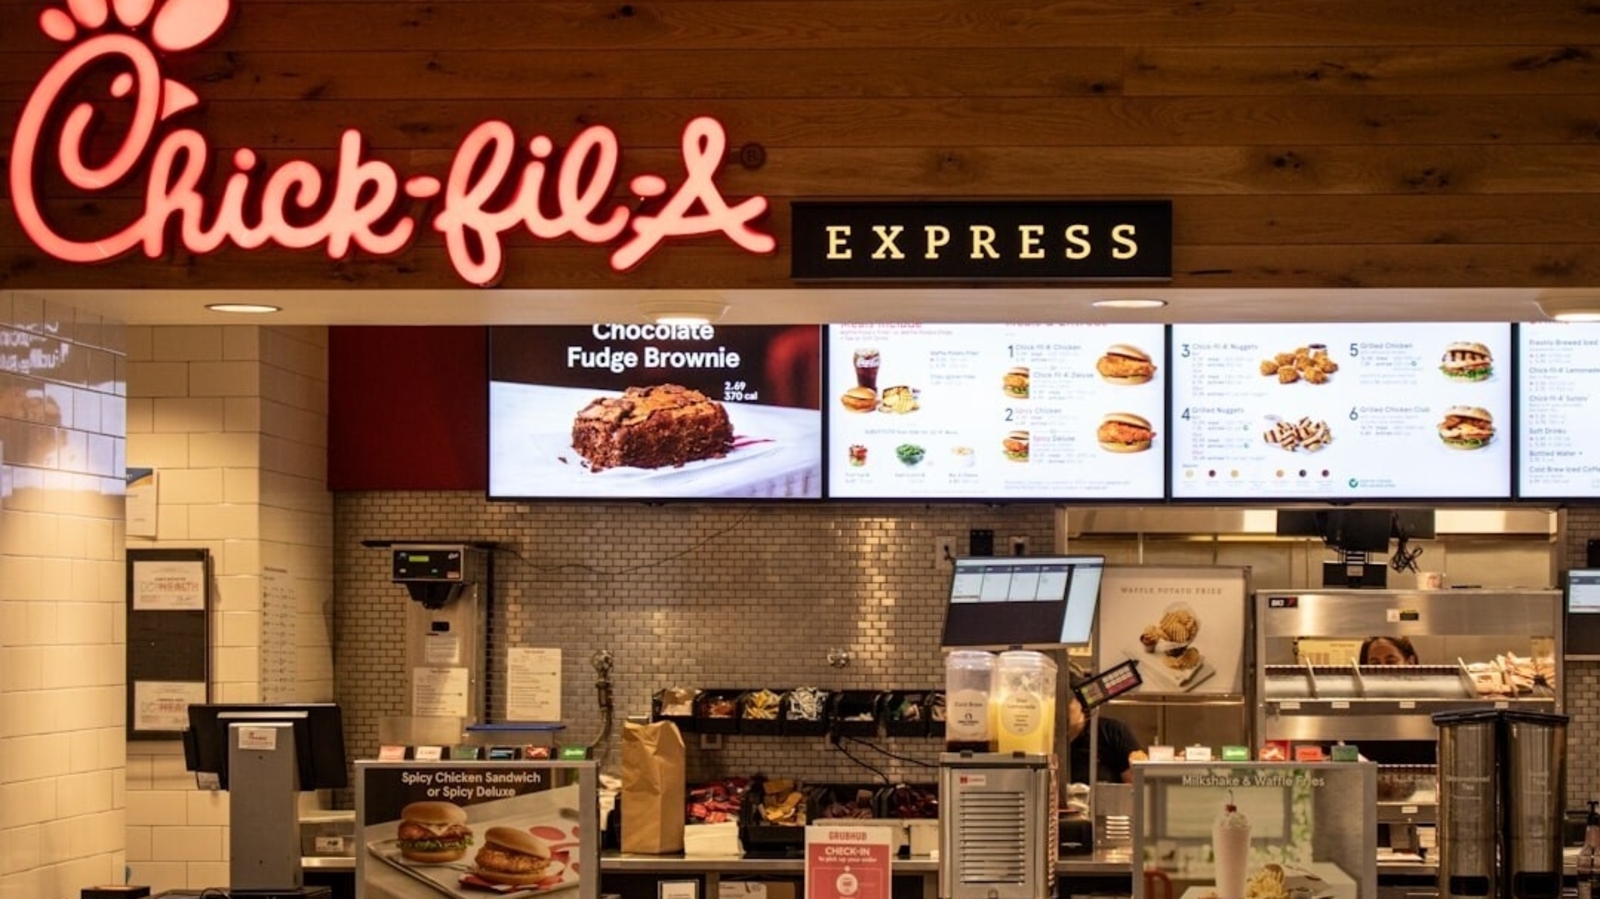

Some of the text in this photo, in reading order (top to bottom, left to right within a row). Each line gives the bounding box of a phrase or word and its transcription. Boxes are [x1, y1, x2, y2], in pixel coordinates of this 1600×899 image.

[10, 32, 777, 286] Chick-fil-A
[825, 223, 1138, 260] EXPRESS
[592, 324, 715, 341] Chocolate
[1007, 344, 1014, 358] 1
[1181, 344, 1191, 358] 3
[1349, 343, 1359, 357] 5
[567, 346, 740, 373] Fudge Brownie
[724, 381, 747, 391] 2.69
[724, 391, 758, 400] 370 cal
[1004, 408, 1014, 422] 2
[1181, 407, 1191, 421] 4
[1349, 406, 1359, 421] 6
[401, 771, 542, 785] Spicy Chicken Sandwich
[1182, 776, 1240, 787] Milkshake
[1242, 776, 1250, 787] &
[1255, 776, 1293, 787] Waffle
[427, 786, 516, 799] or Spicy Deluxe
[828, 831, 867, 840] GRUBHUB
[824, 846, 871, 856] CHECK-IN
